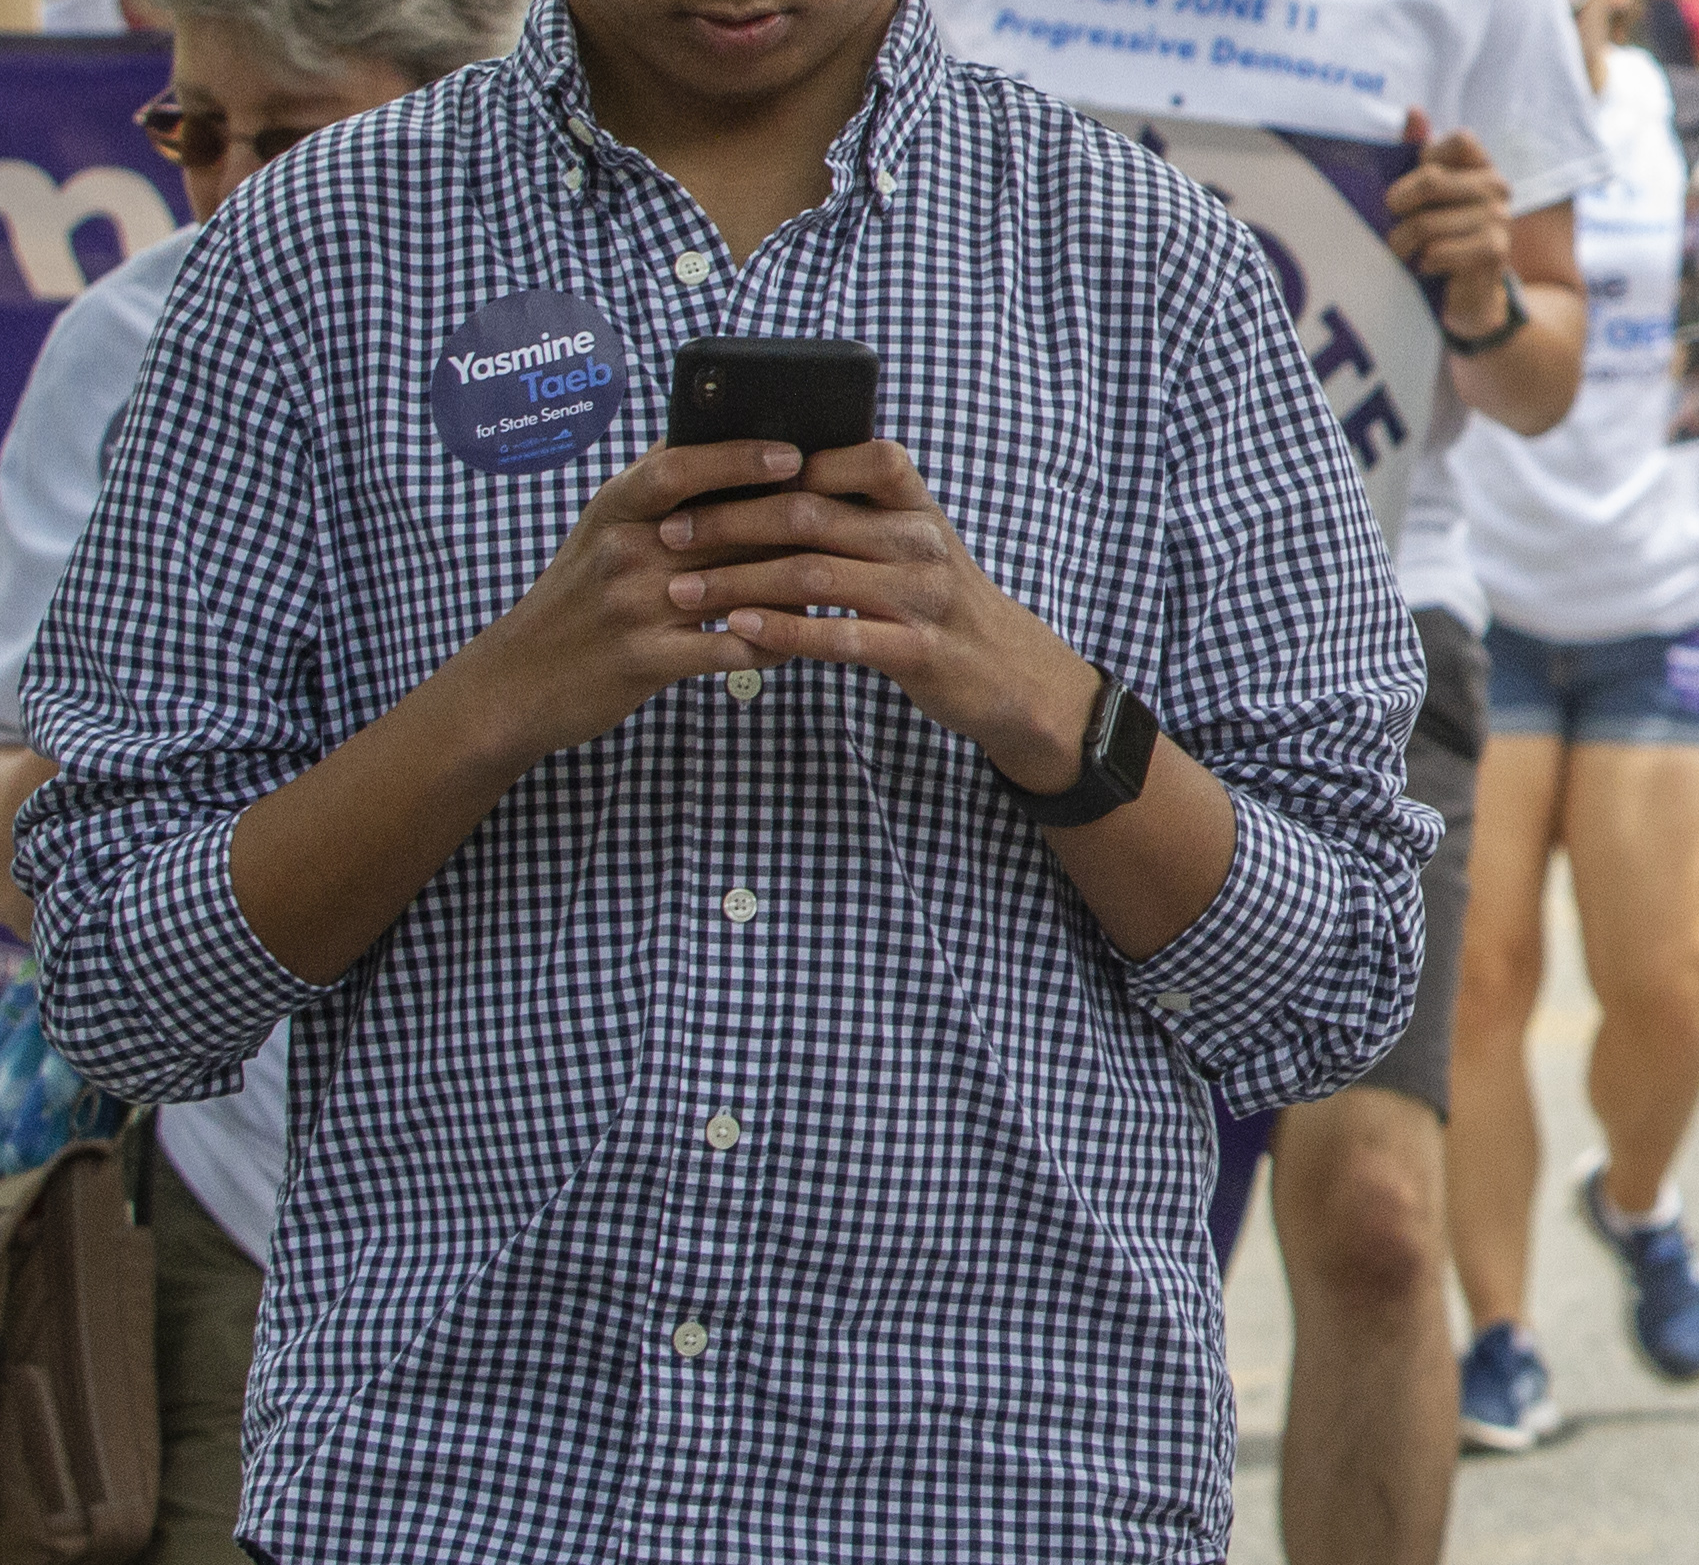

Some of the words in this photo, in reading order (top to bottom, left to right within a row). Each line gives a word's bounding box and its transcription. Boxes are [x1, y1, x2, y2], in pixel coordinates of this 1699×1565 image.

[1287, 0, 1318, 33] 11
[993, 7, 1196, 60] Progressive
[1210, 36, 1386, 96] Democrat
[448, 330, 596, 385] Yasmine
[518, 356, 613, 404] Taeb
[475, 423, 497, 439] for
[499, 413, 539, 434] State
[540, 398, 594, 423] Senate
